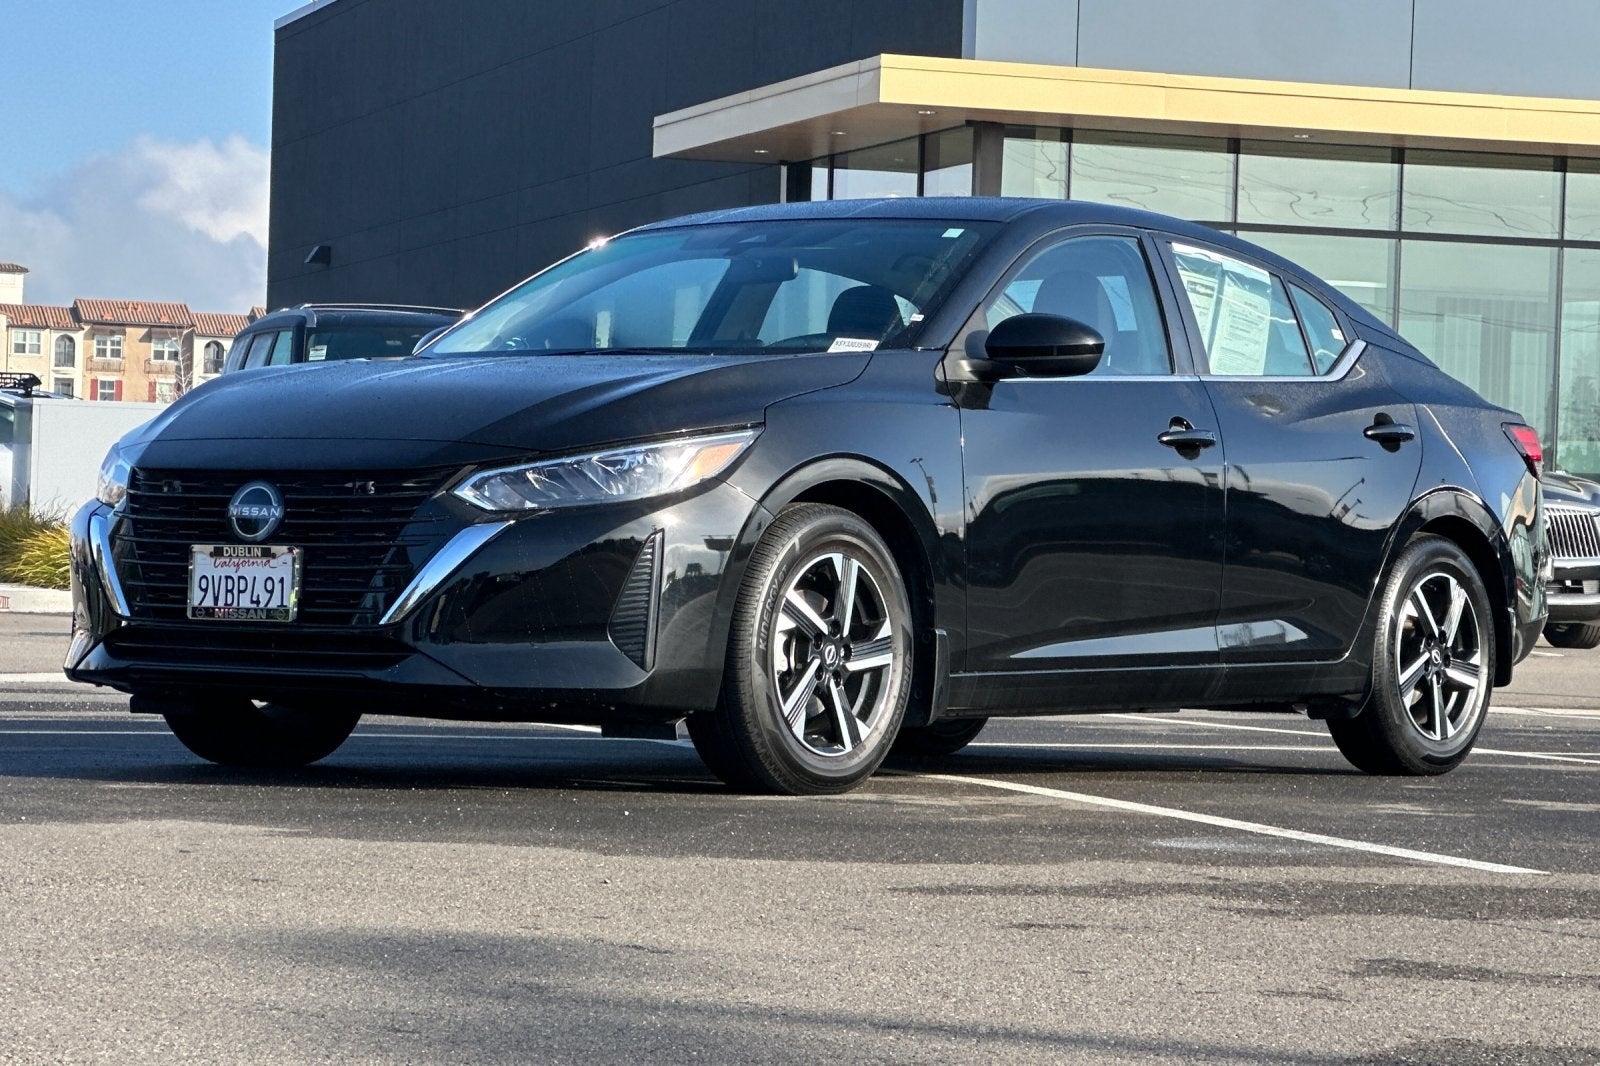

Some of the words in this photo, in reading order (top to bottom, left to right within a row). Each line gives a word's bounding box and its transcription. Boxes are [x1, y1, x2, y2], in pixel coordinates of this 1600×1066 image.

[229, 507, 280, 517] NISSAN
[223, 546, 262, 557] DUBLIN
[213, 558, 277, 573] California
[198, 574, 288, 608] 9VBP491
[214, 608, 267, 619] NISSAN
[760, 579, 778, 650] KINERGY
